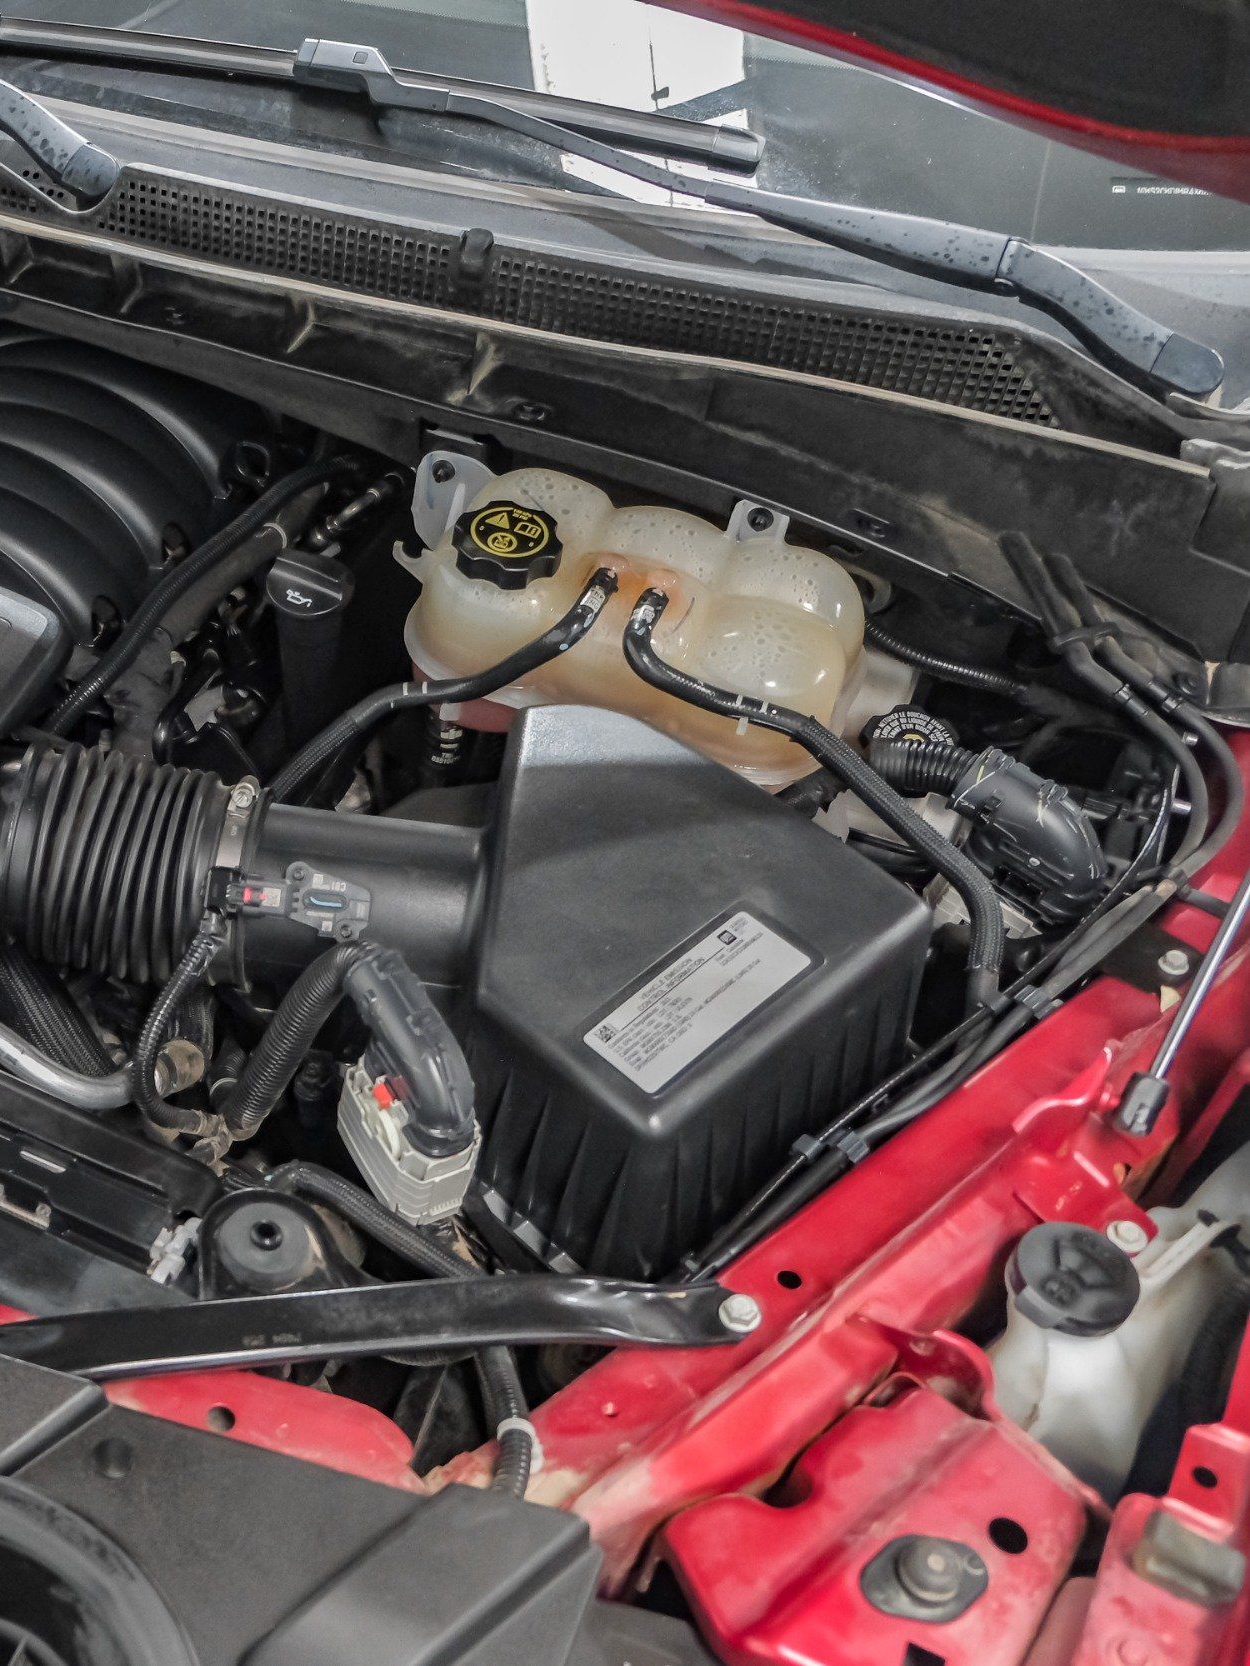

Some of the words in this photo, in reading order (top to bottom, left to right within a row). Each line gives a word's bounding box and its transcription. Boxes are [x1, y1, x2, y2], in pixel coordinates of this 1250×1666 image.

[930, 719, 945, 731] AVANT
[637, 988, 667, 1011] CONTROL
[664, 957, 706, 990] INFORMATION
[639, 978, 666, 1000] VEHICLE
[664, 957, 693, 981] EMISSION
